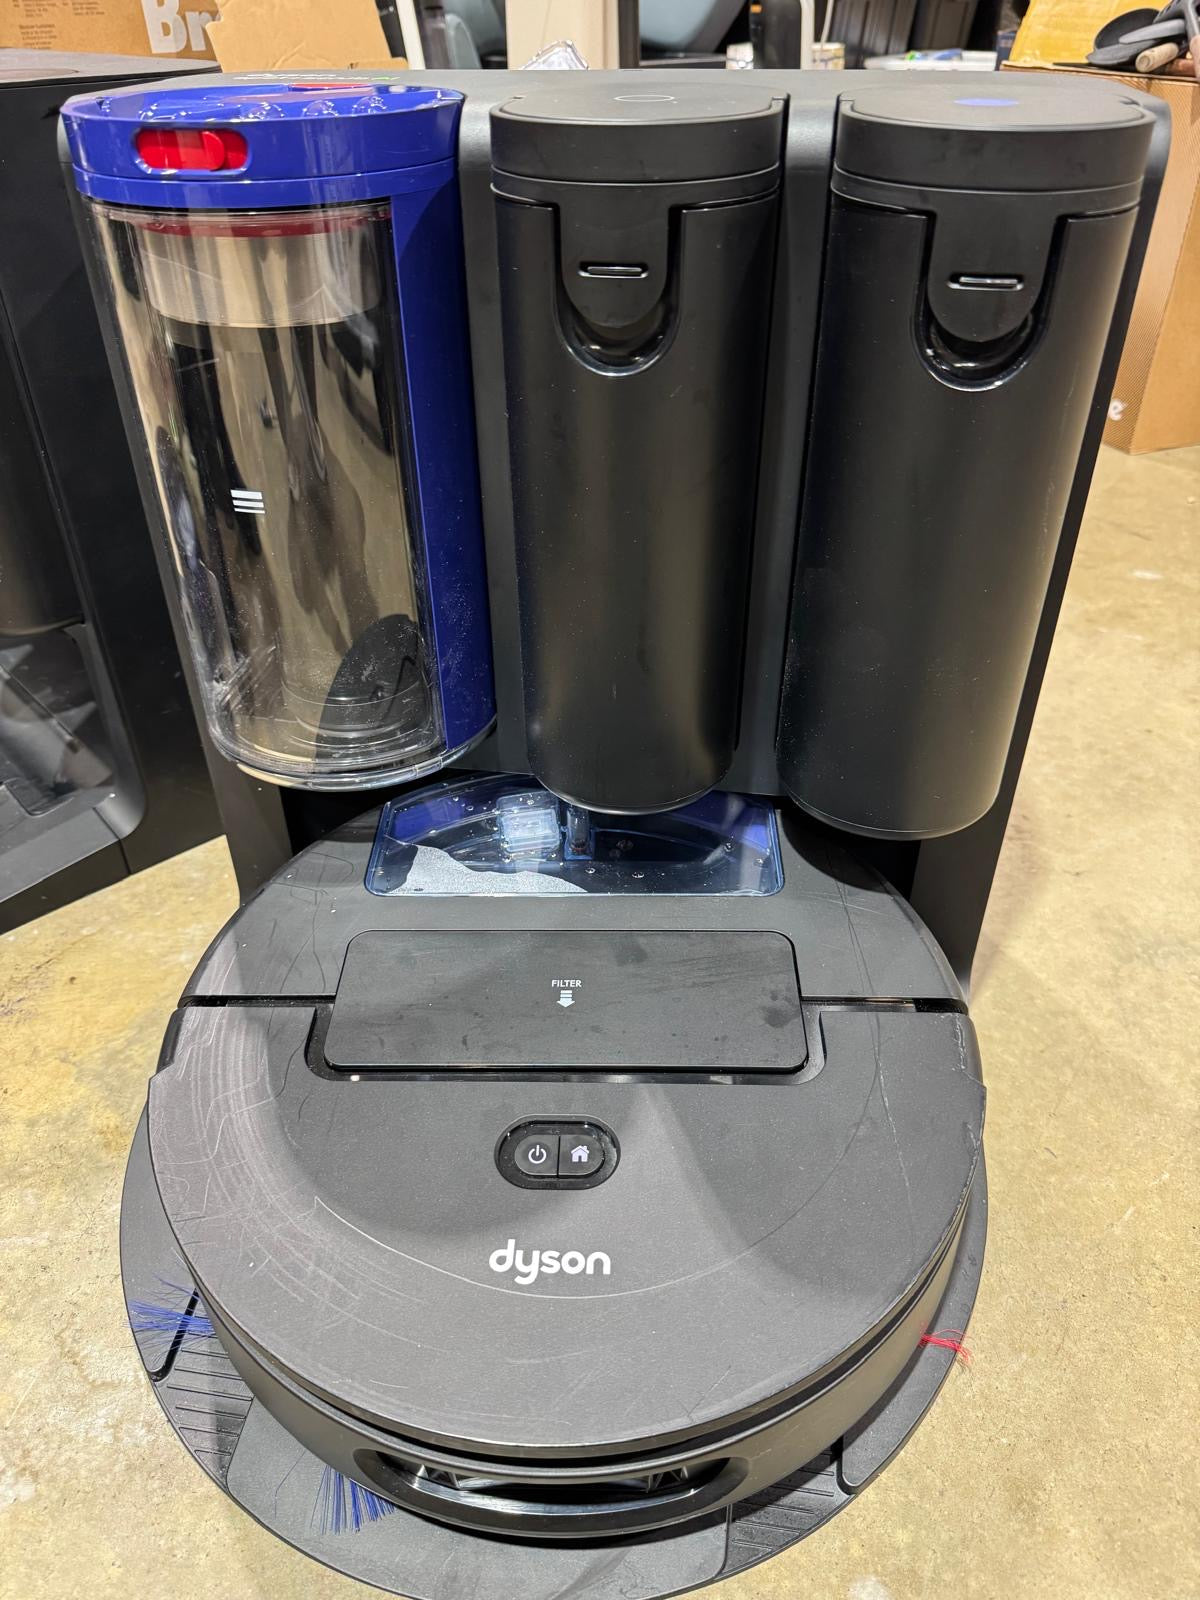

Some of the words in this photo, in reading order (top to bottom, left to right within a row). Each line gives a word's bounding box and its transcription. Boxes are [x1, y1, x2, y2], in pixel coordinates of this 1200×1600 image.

[141, 0, 222, 54] Br
[551, 979, 582, 988] FILTER
[488, 1238, 612, 1285] dyson
